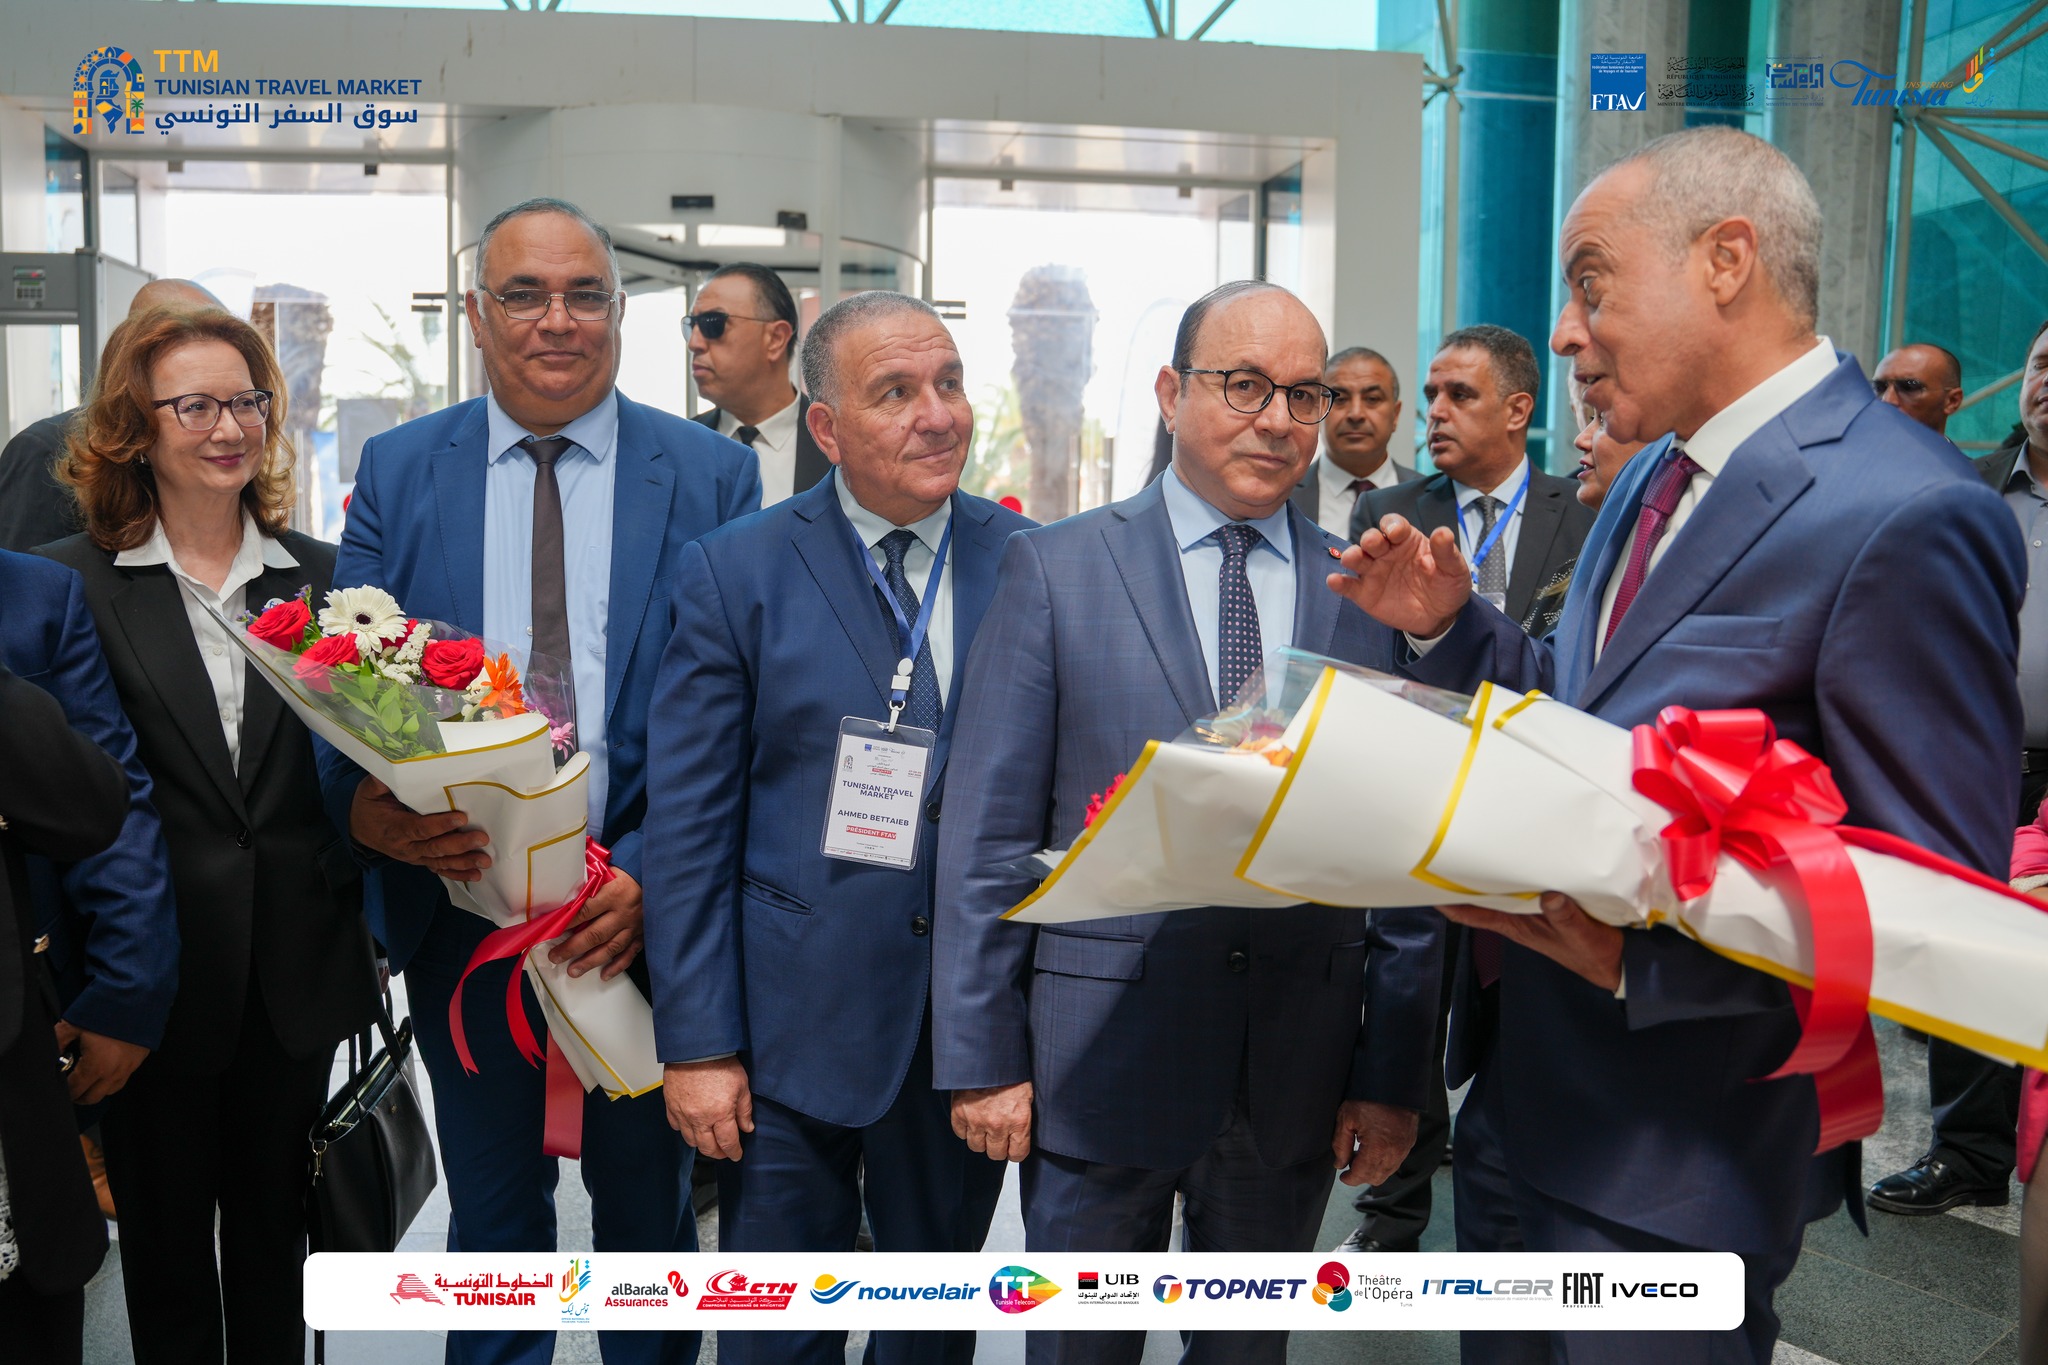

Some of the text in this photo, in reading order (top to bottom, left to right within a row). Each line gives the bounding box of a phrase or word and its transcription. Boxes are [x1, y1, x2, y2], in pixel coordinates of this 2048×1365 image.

[842, 780, 914, 798] TUNISIAN TRAVEL
[860, 790, 895, 800] MARKET
[837, 809, 909, 827] AHMED BETTAIEB
[846, 825, 880, 836] PRÉSIDENT
